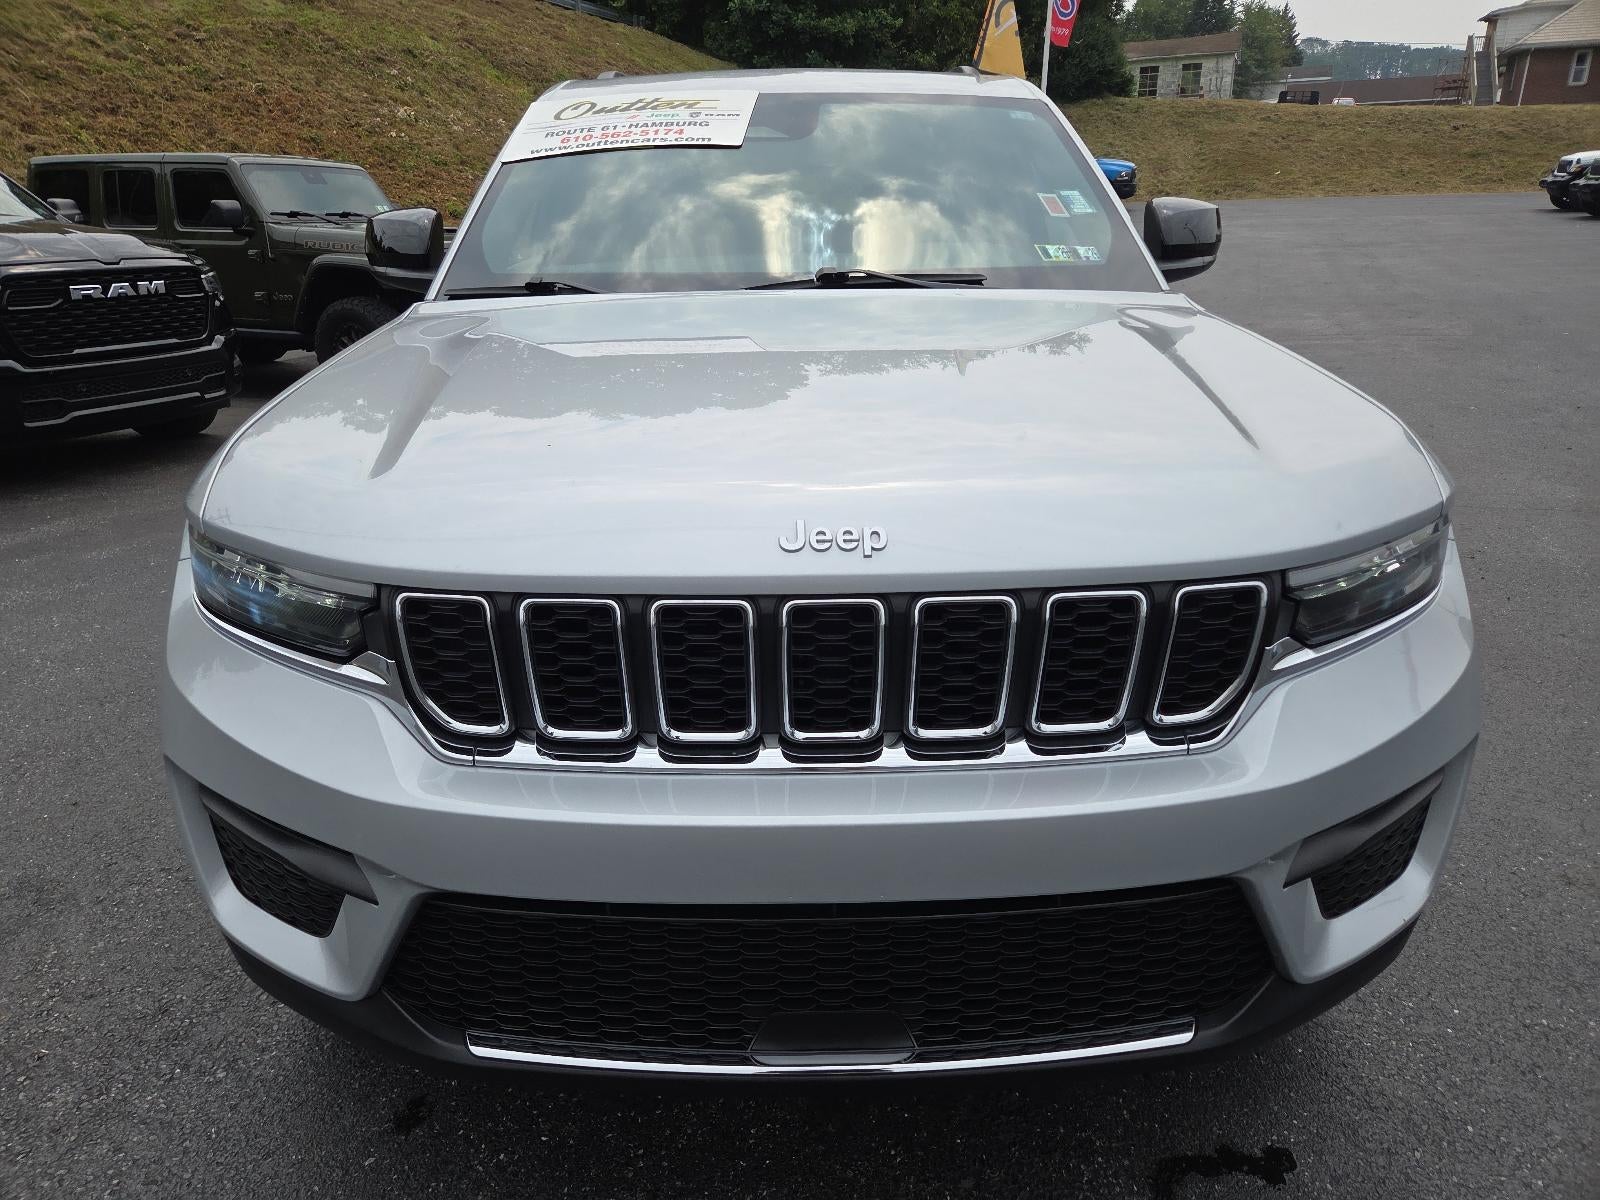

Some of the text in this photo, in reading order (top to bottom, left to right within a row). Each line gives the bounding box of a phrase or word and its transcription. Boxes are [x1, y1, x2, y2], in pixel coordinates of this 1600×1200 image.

[554, 97, 720, 121] Outten
[545, 126, 597, 138] ROUTE
[560, 128, 685, 144] 610-562-5174
[530, 136, 712, 155] www.outtencars.com
[303, 239, 365, 252] RUBIC
[69, 280, 166, 300] RAM
[778, 519, 888, 558] Jeep
